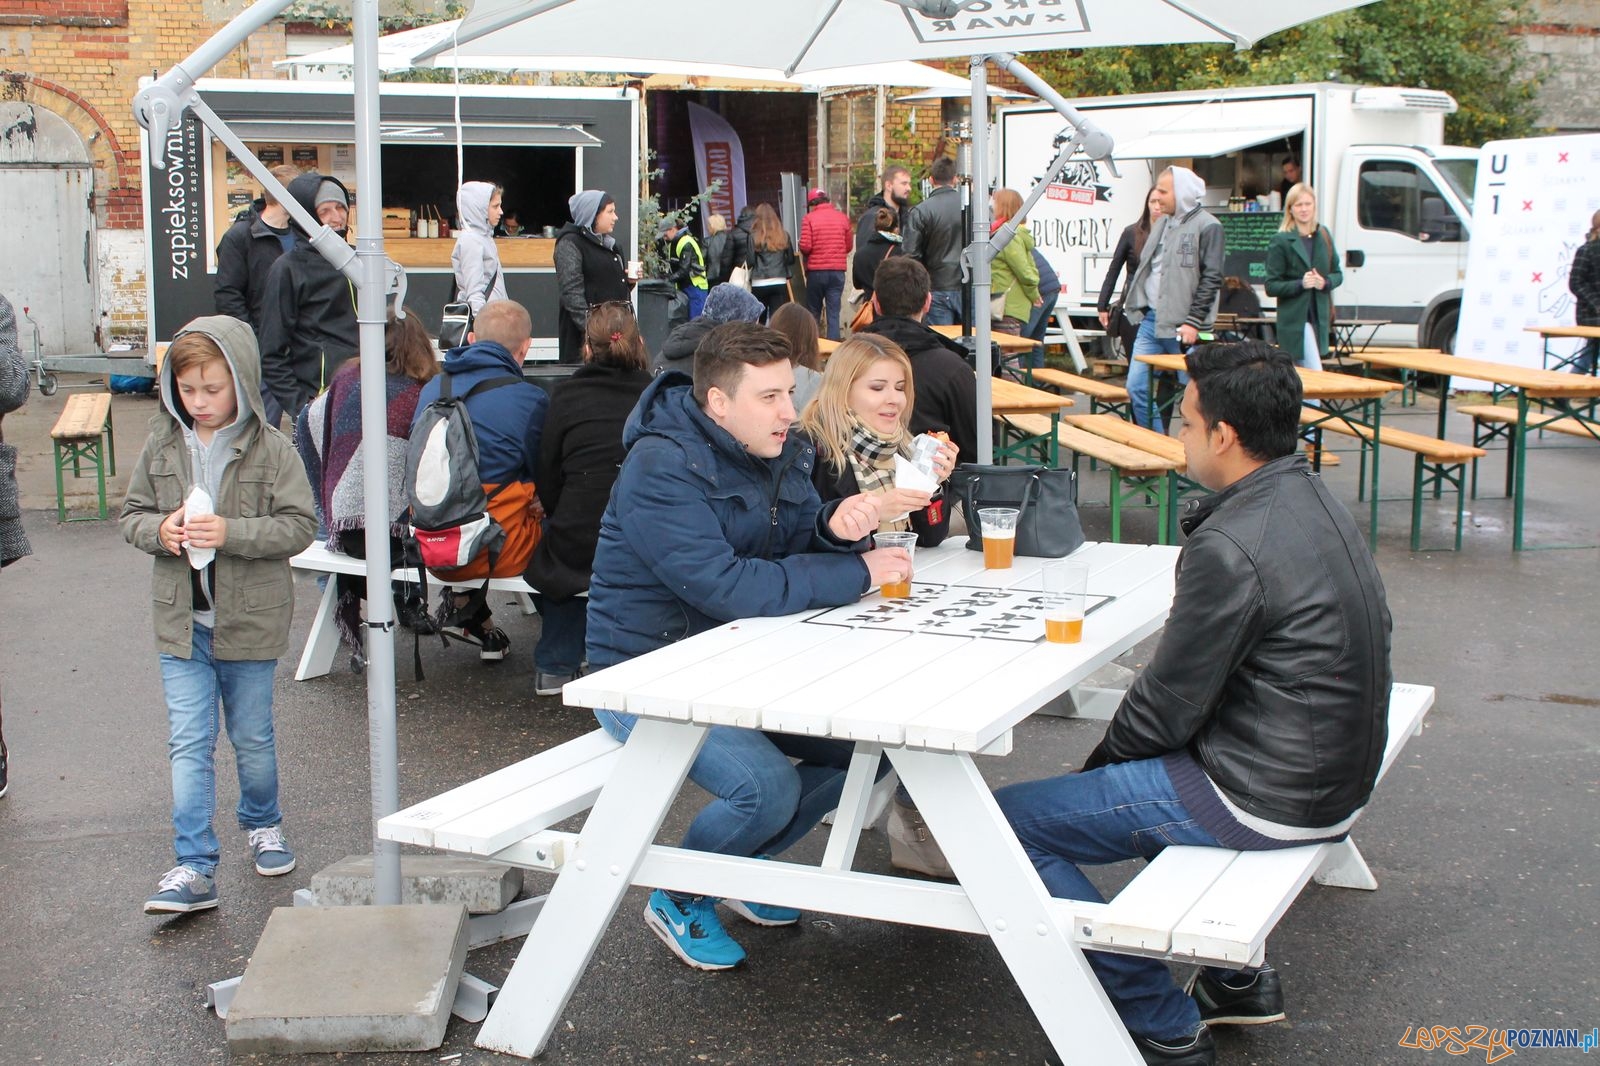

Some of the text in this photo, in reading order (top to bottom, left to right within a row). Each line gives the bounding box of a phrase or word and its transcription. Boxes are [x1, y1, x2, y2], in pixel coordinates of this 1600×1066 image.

[1491, 154, 1508, 174] U
[190, 201, 199, 238] dobre
[1033, 217, 1113, 253] BURGERY
